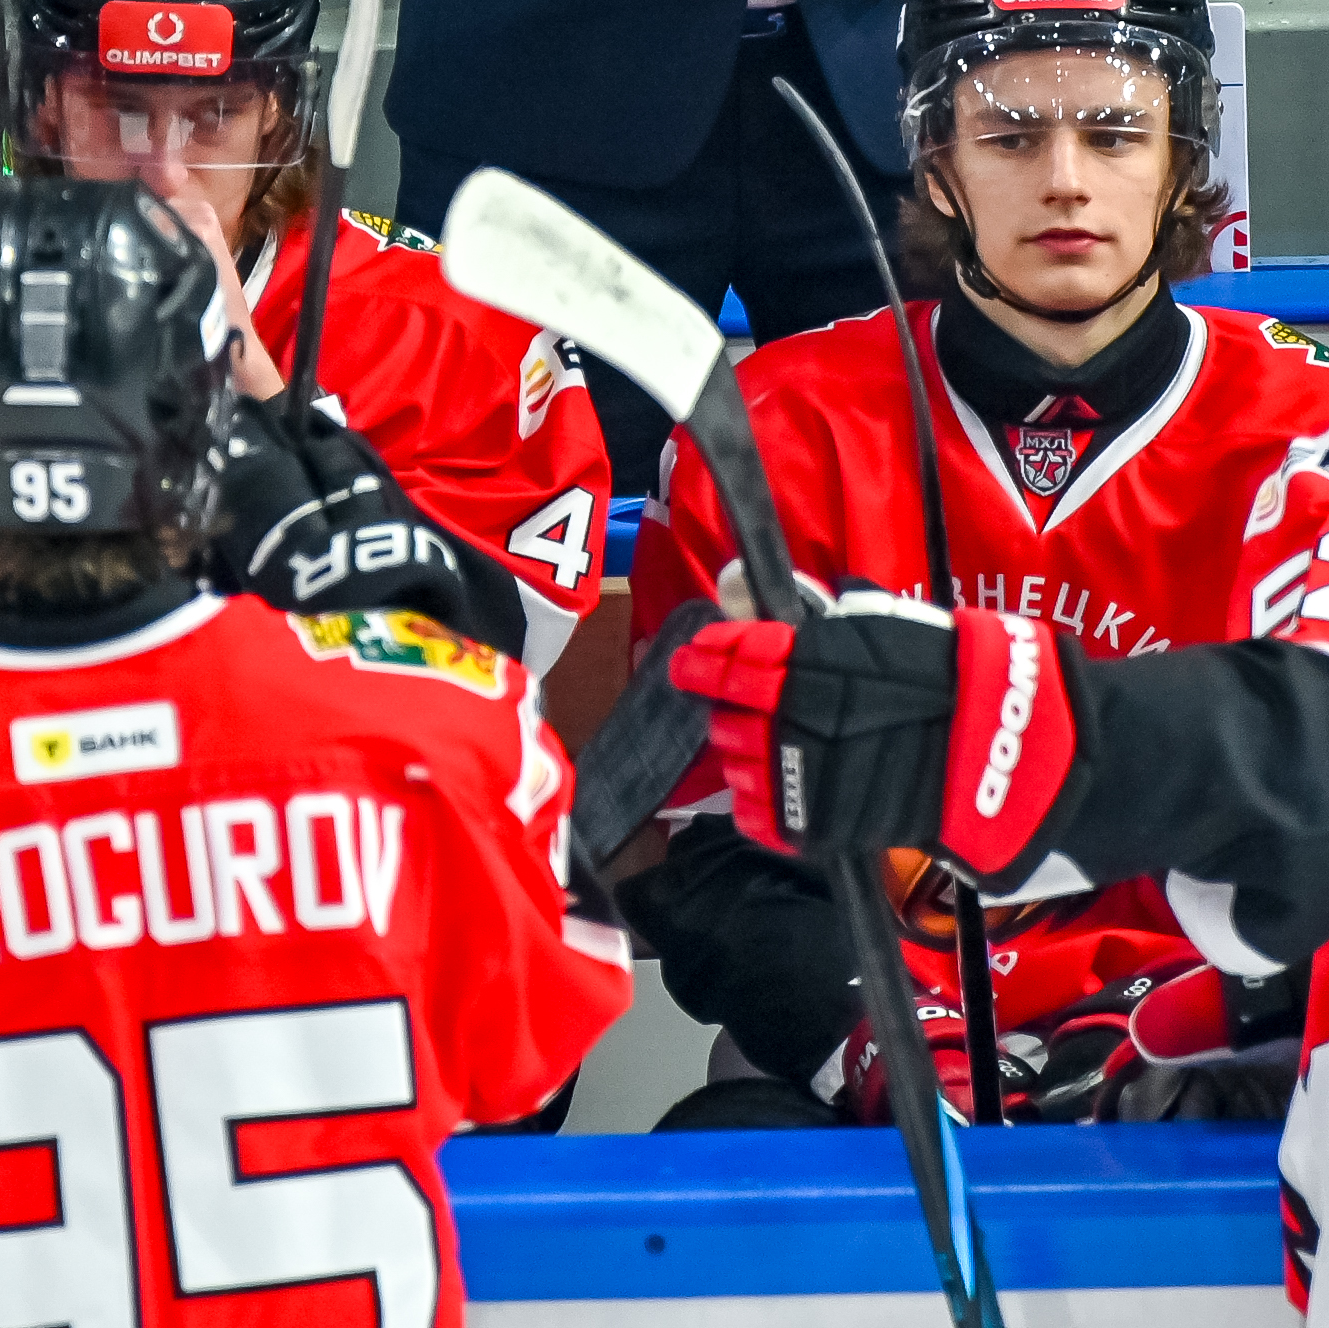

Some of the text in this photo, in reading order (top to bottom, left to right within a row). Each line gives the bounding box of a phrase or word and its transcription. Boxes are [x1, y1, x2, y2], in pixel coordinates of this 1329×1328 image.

[105, 48, 223, 68] OLIMPBET
[1026, 437, 1066, 450] МХЛ
[10, 460, 92, 524] 95
[78, 728, 159, 755] БАНК
